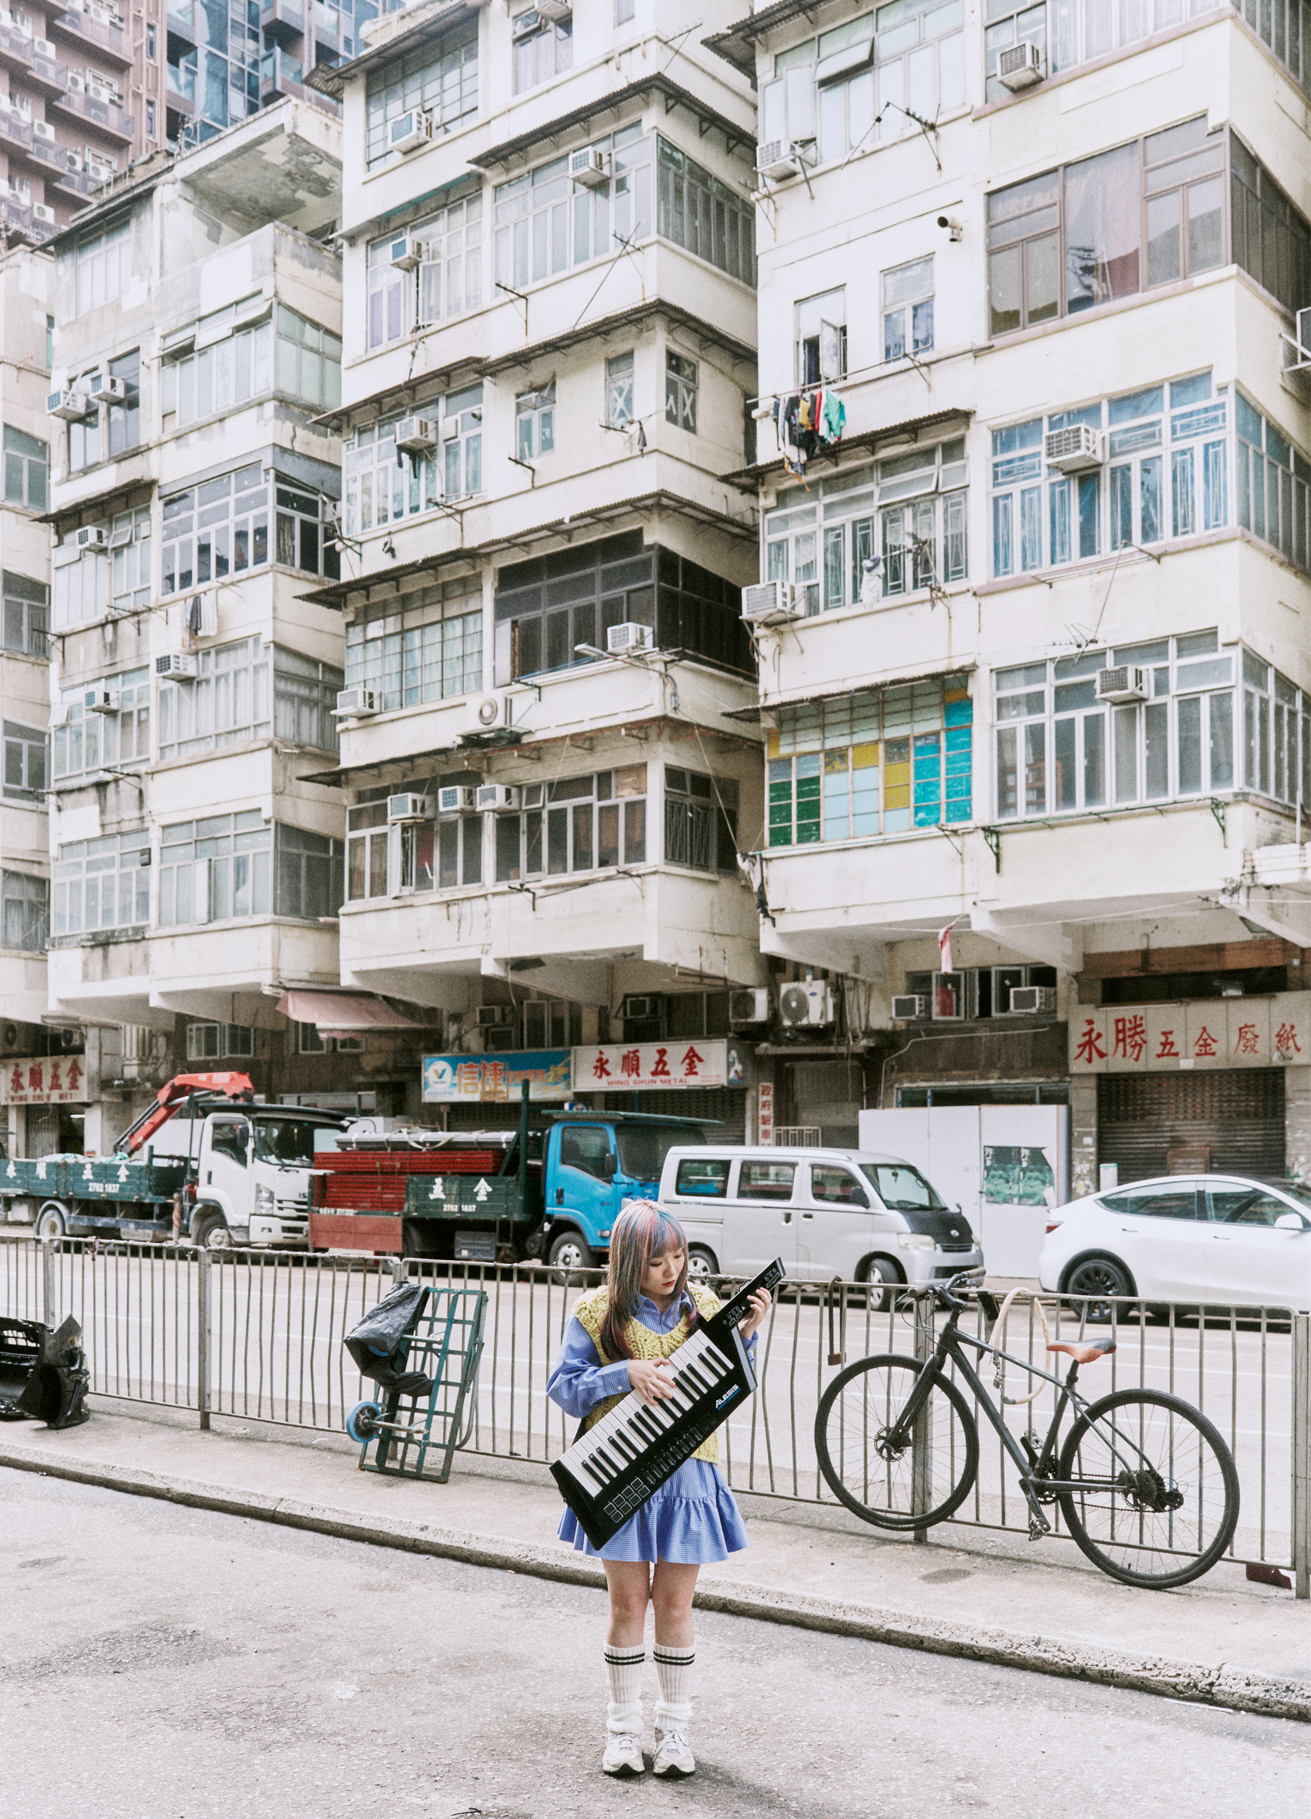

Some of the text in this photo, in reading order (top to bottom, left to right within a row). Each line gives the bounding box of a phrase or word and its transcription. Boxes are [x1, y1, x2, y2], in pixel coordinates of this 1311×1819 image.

[1073, 1014, 1301, 1064] 永勝五金廢紙
[593, 1046, 704, 1079] 永順五金
[660, 1077, 689, 1085] METAL
[10, 1094, 28, 1103] WING
[715, 1383, 740, 1409] ALESIS
